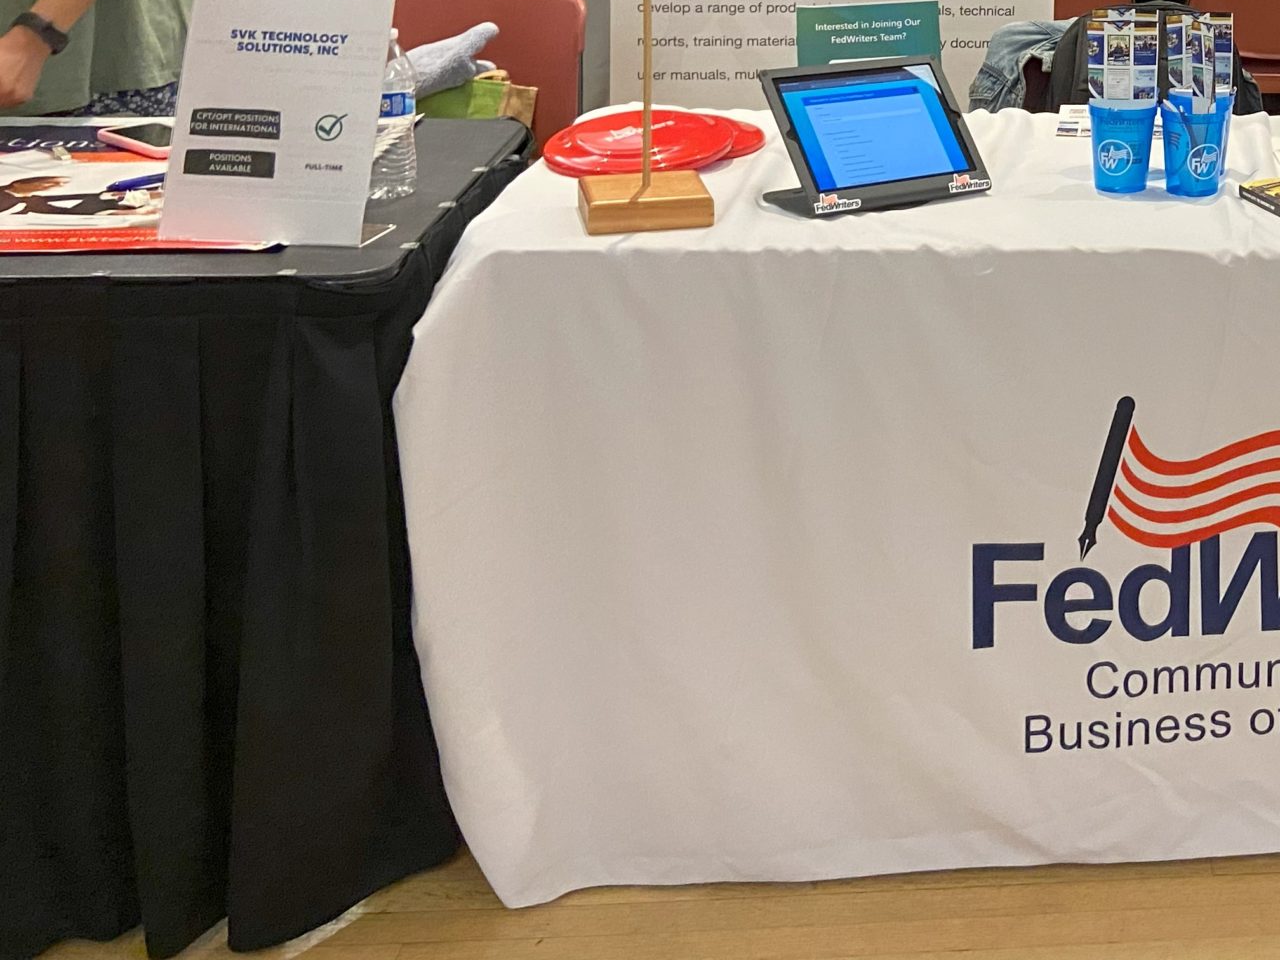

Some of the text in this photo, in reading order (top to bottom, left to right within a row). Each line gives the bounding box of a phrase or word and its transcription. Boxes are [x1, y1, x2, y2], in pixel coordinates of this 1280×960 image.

[695, 4, 703, 14] a
[707, 4, 745, 16] range
[749, 2, 762, 13] of
[766, 2, 796, 15] prod
[960, 5, 1015, 17] technical
[815, 18, 921, 32] Interested in Joining Our
[230, 29, 348, 44] SVK TECHNOLOGY
[637, 36, 689, 48] rports,
[693, 36, 742, 49] training
[831, 32, 907, 44] FedWriters Team?
[237, 41, 339, 56] SOLUTIONS, INC
[637, 71, 666, 80] uer
[670, 69, 730, 81] manuals,
[234, 114, 280, 124] POSITIONS
[190, 122, 277, 134] FOR INTERNATIONAL
[209, 153, 252, 162] POSITIONS
[209, 163, 251, 173] AVAILABLE
[304, 163, 344, 171] FULL-TIME
[950, 179, 990, 192] FedWriters
[815, 200, 860, 213] FedWriters
[1024, 711, 1231, 753] Business
